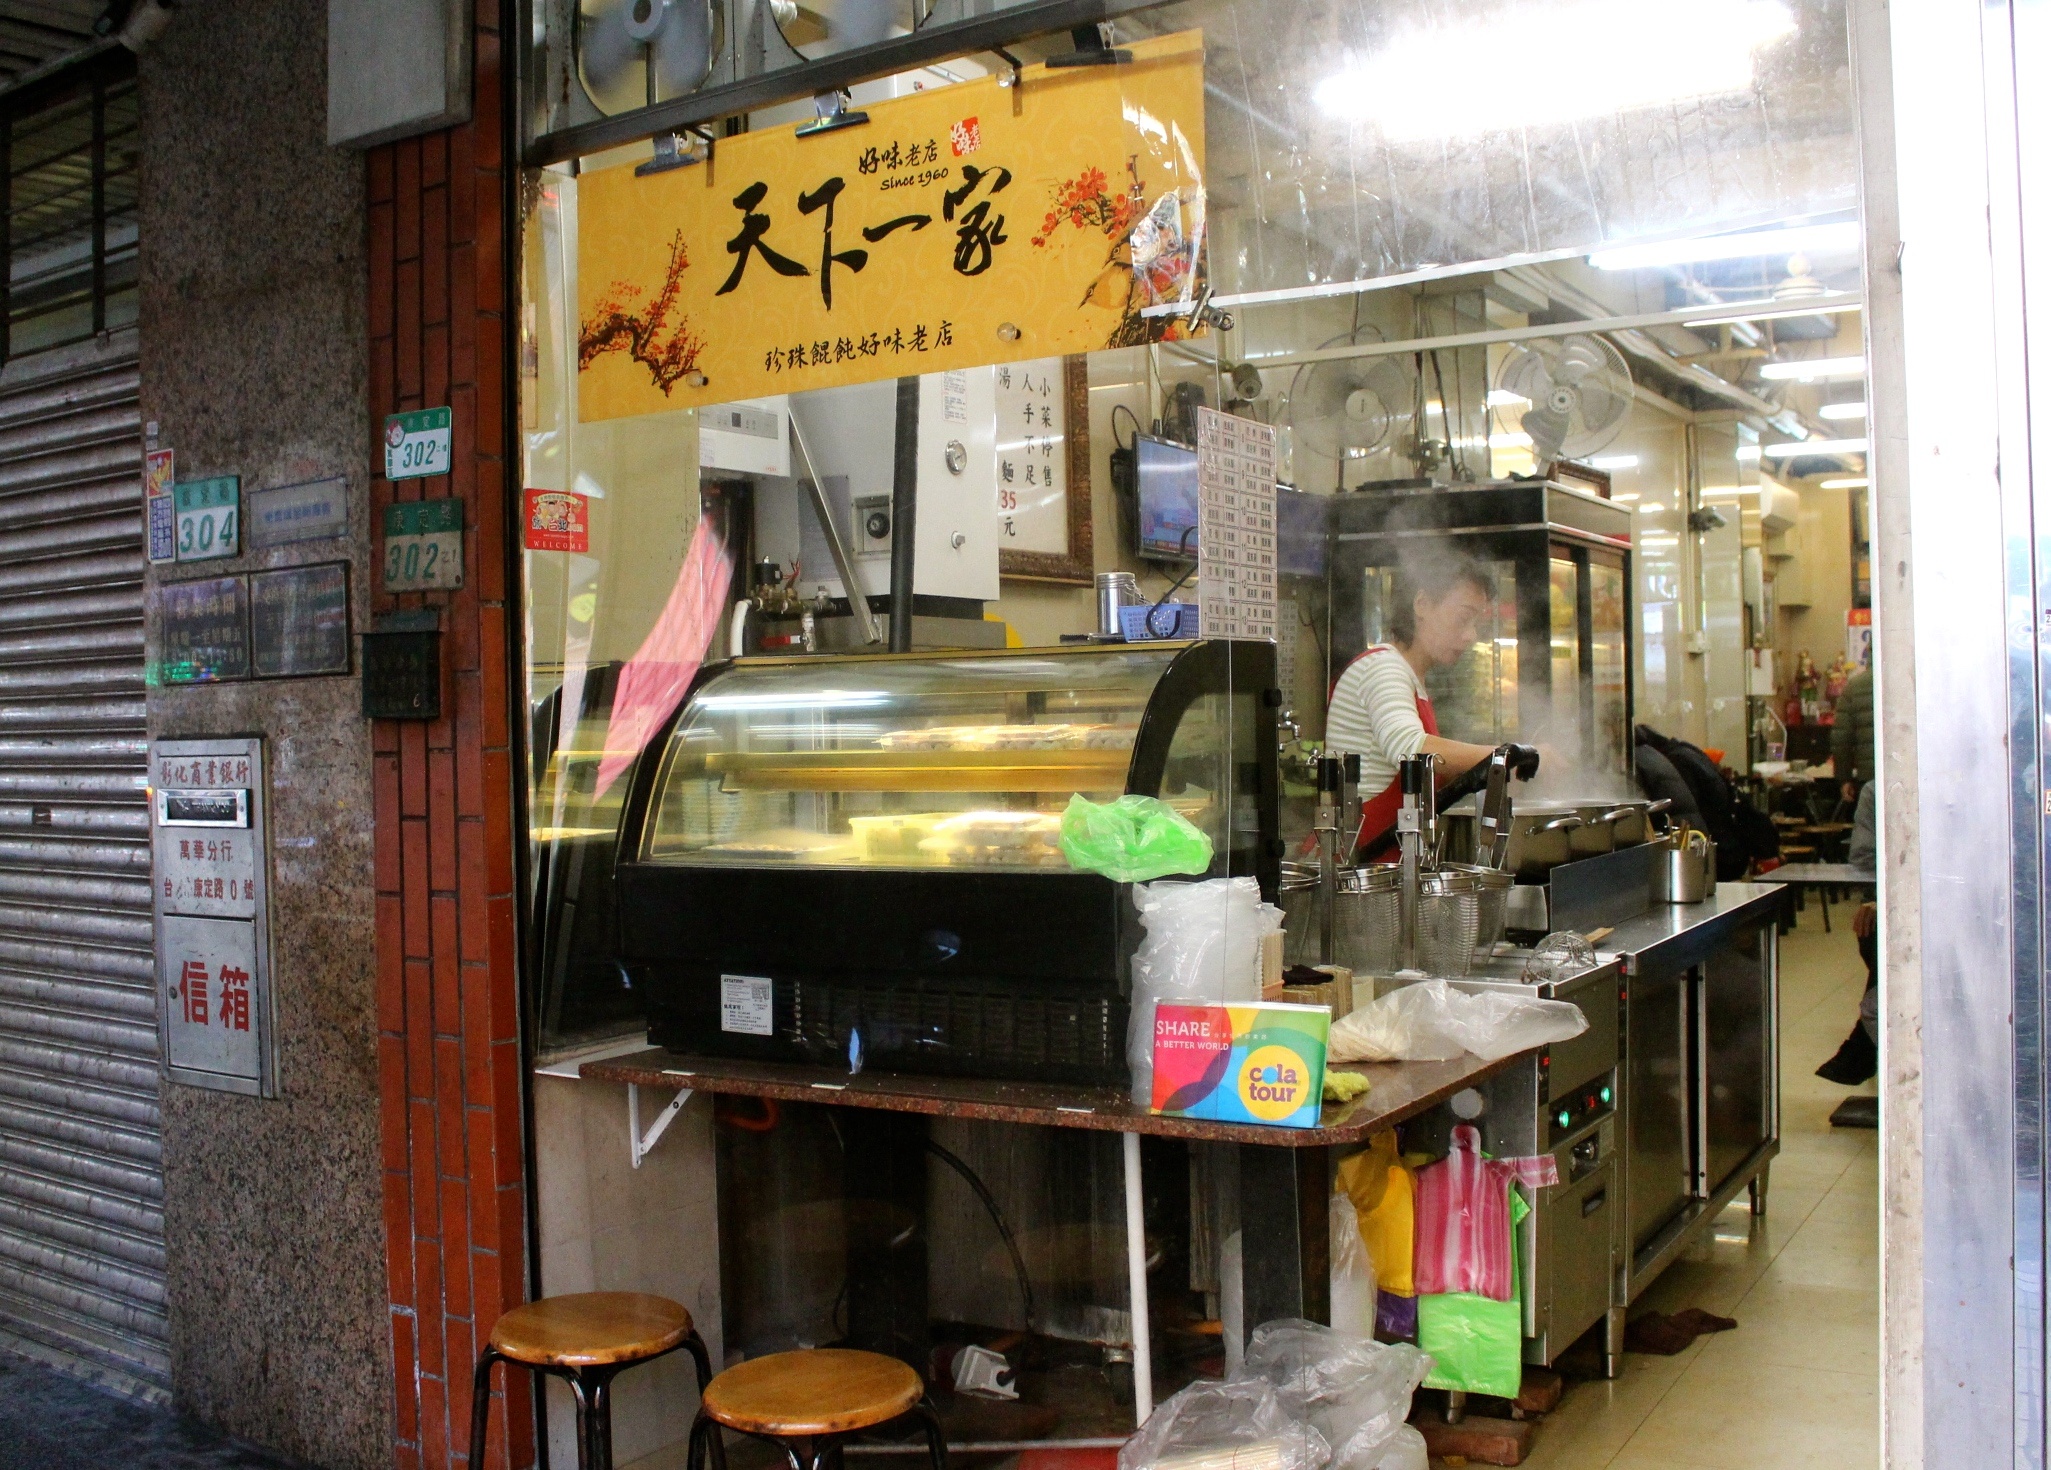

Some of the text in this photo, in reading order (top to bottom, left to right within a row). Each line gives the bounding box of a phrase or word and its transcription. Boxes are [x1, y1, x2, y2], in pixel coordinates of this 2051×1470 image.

[859, 139, 938, 174] 好味老店
[917, 167, 949, 188] 1960
[715, 165, 1012, 313] 天下一家
[765, 320, 954, 374] 珍珠餛飩好味老店
[1022, 372, 1037, 486] 人手不足
[403, 440, 436, 469] 302
[180, 510, 234, 554] 304
[533, 540, 583, 549] WELCOME
[385, 542, 439, 582] 302
[161, 760, 249, 786] 彰化商業銀行
[179, 839, 232, 862] 萬華分行
[179, 960, 250, 1032] 信箱
[1156, 1020, 1210, 1037] SHARE
[1155, 1040, 1229, 1051] A BETTER WORLD
[1249, 1063, 1298, 1085] cola
[1249, 1083, 1297, 1103] tour
